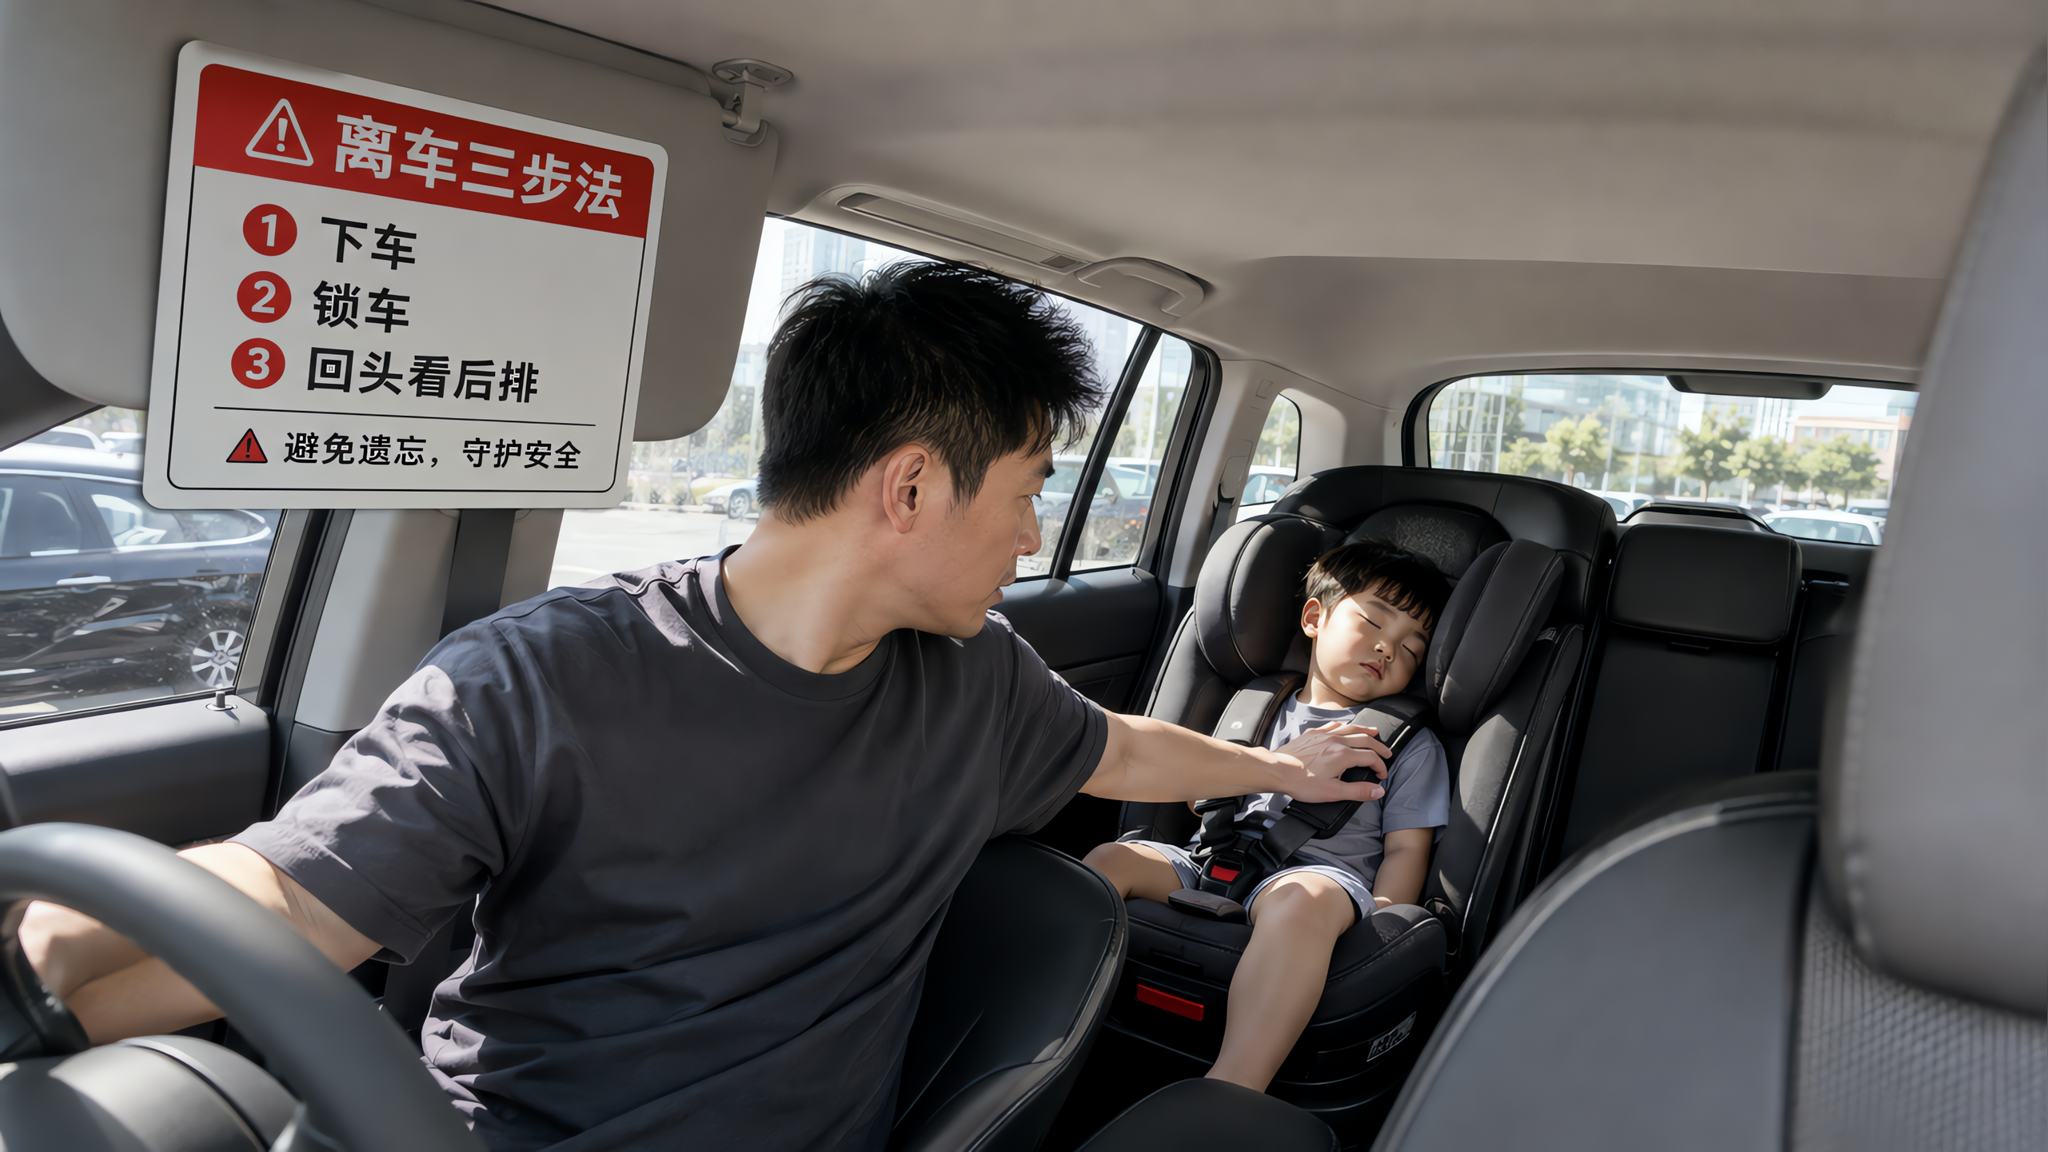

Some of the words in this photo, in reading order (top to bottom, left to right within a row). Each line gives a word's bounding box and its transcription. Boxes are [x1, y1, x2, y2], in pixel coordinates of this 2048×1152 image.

[334, 114, 623, 219] 离车三步法
[261, 213, 278, 247] 1
[320, 216, 417, 270] 下车
[251, 279, 276, 314] 2
[313, 280, 411, 333] 锁车
[245, 346, 270, 381] 3
[307, 346, 540, 403] 回头看后排
[283, 431, 582, 470] 避免遗忘，守护安全
